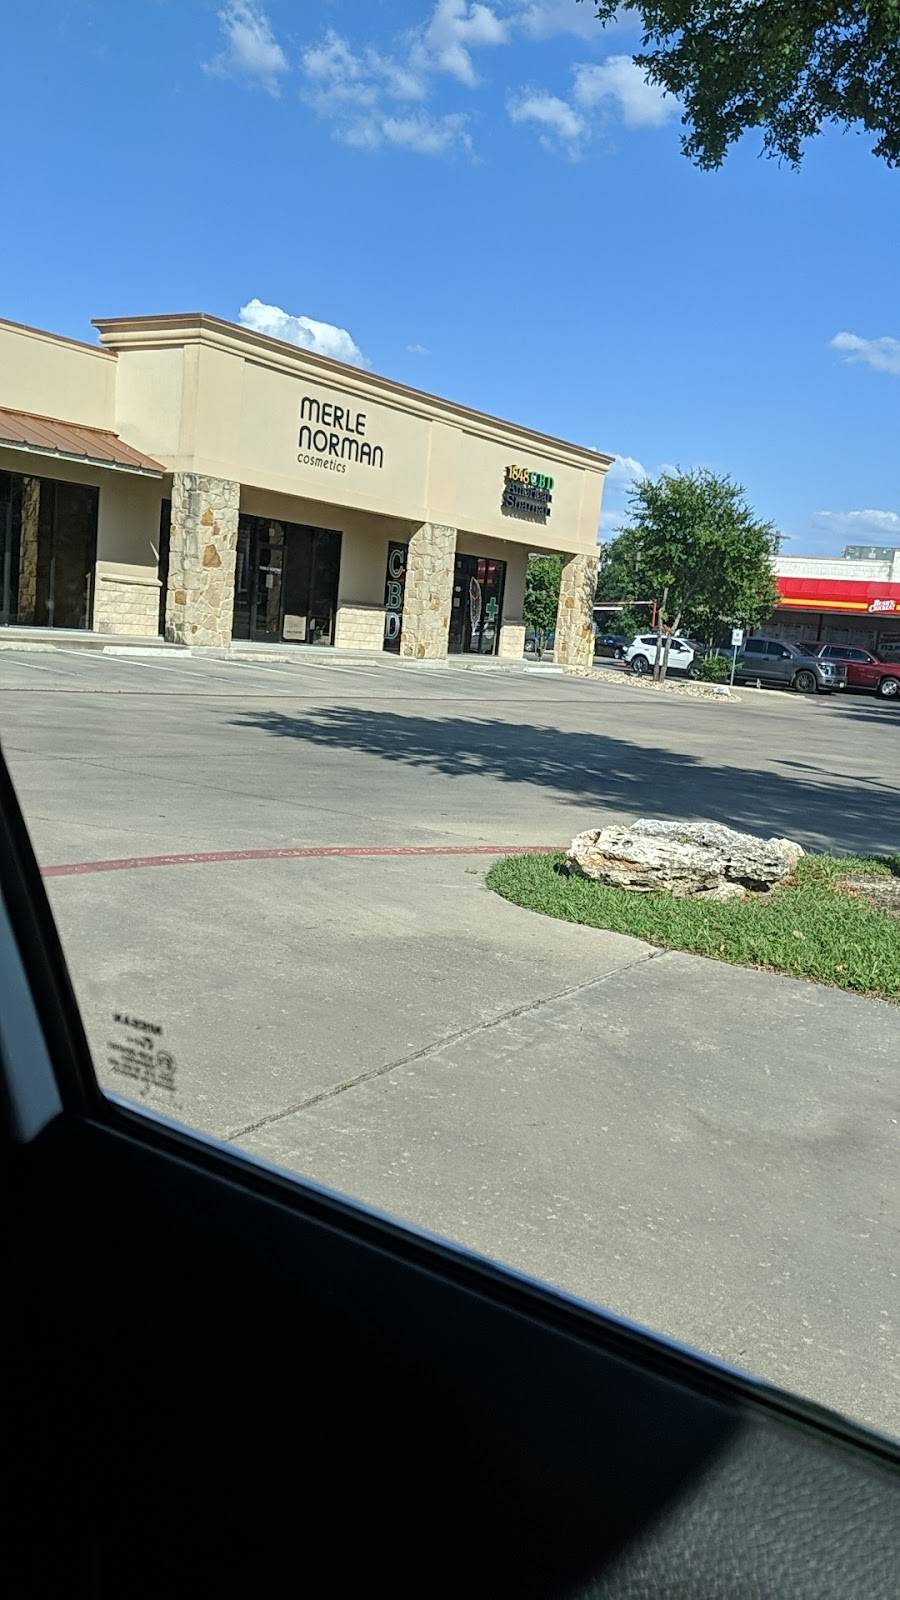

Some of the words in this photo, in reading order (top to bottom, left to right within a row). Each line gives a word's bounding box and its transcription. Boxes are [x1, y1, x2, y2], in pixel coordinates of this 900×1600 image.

[300, 396, 366, 436] MERLE
[297, 453, 346, 473] cosmetics
[298, 425, 384, 468] NORMAN
